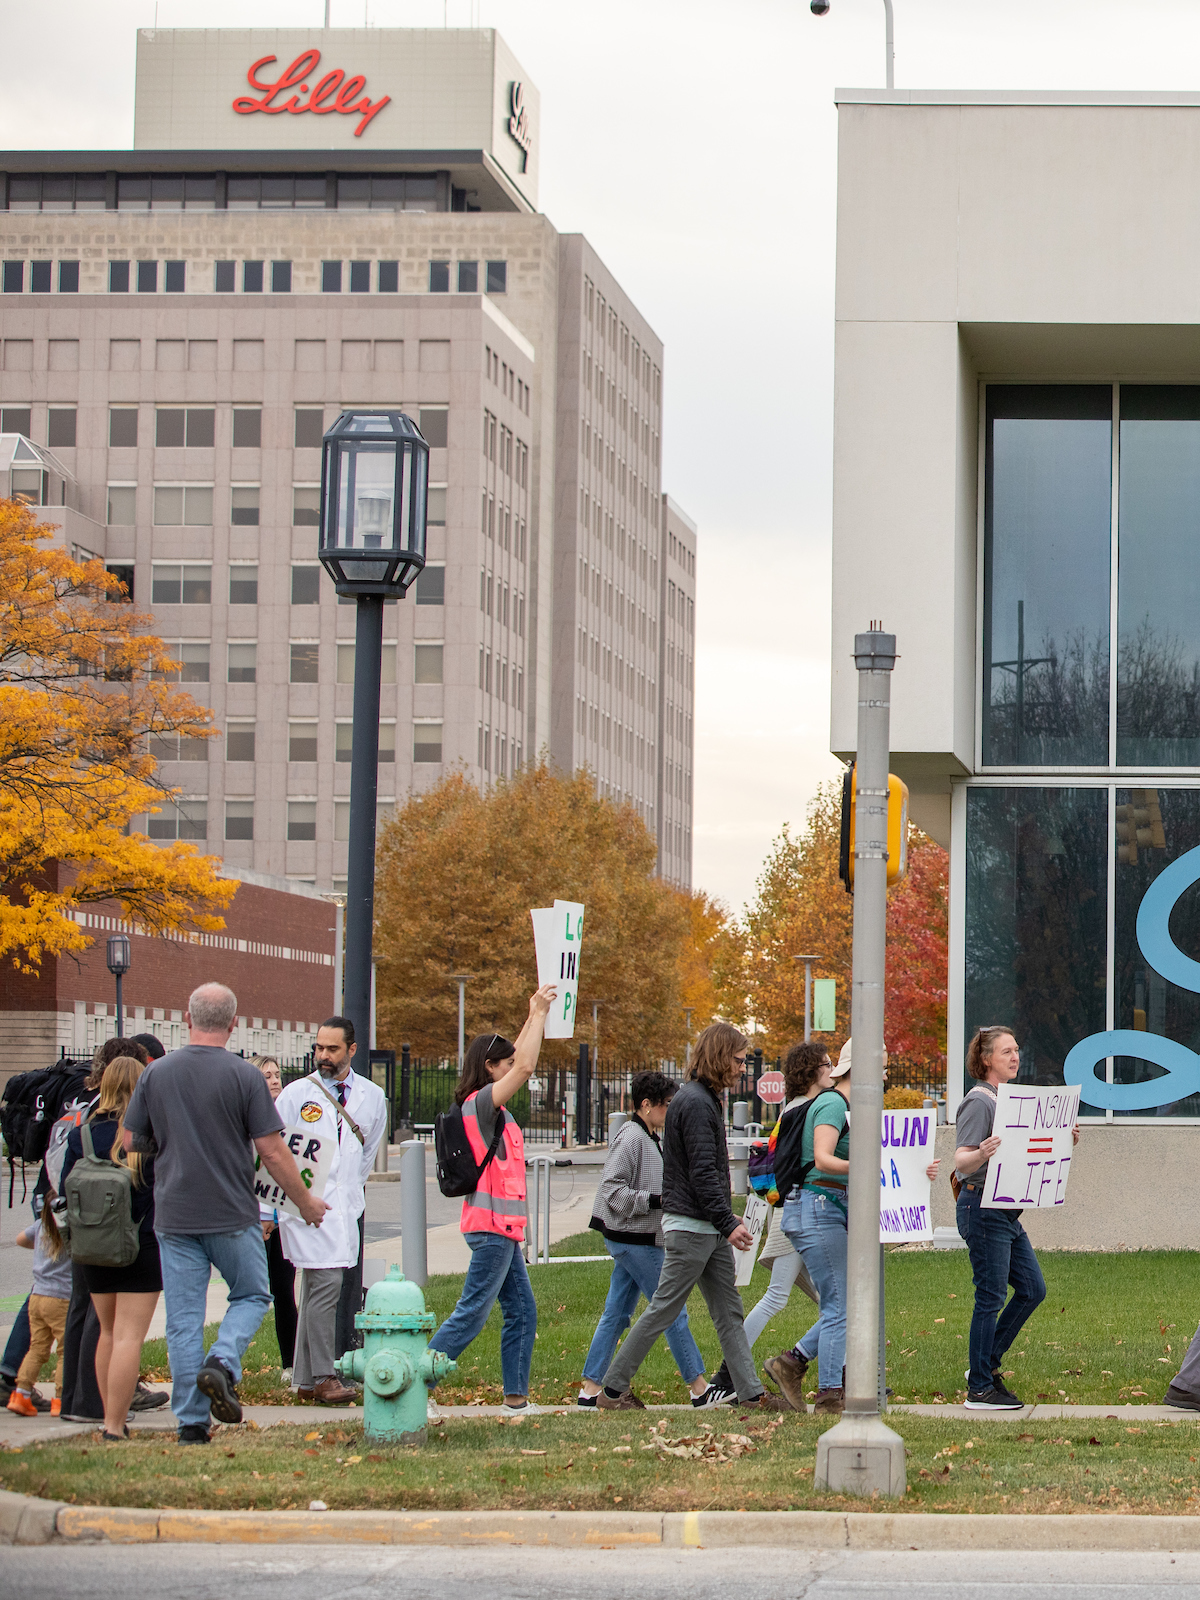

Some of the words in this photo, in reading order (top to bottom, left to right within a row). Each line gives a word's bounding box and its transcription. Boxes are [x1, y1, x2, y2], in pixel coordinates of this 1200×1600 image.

[232, 49, 391, 137] Lilly
[992, 1157, 1071, 1207] LIFE
[900, 1205, 927, 1233] RIGHT
